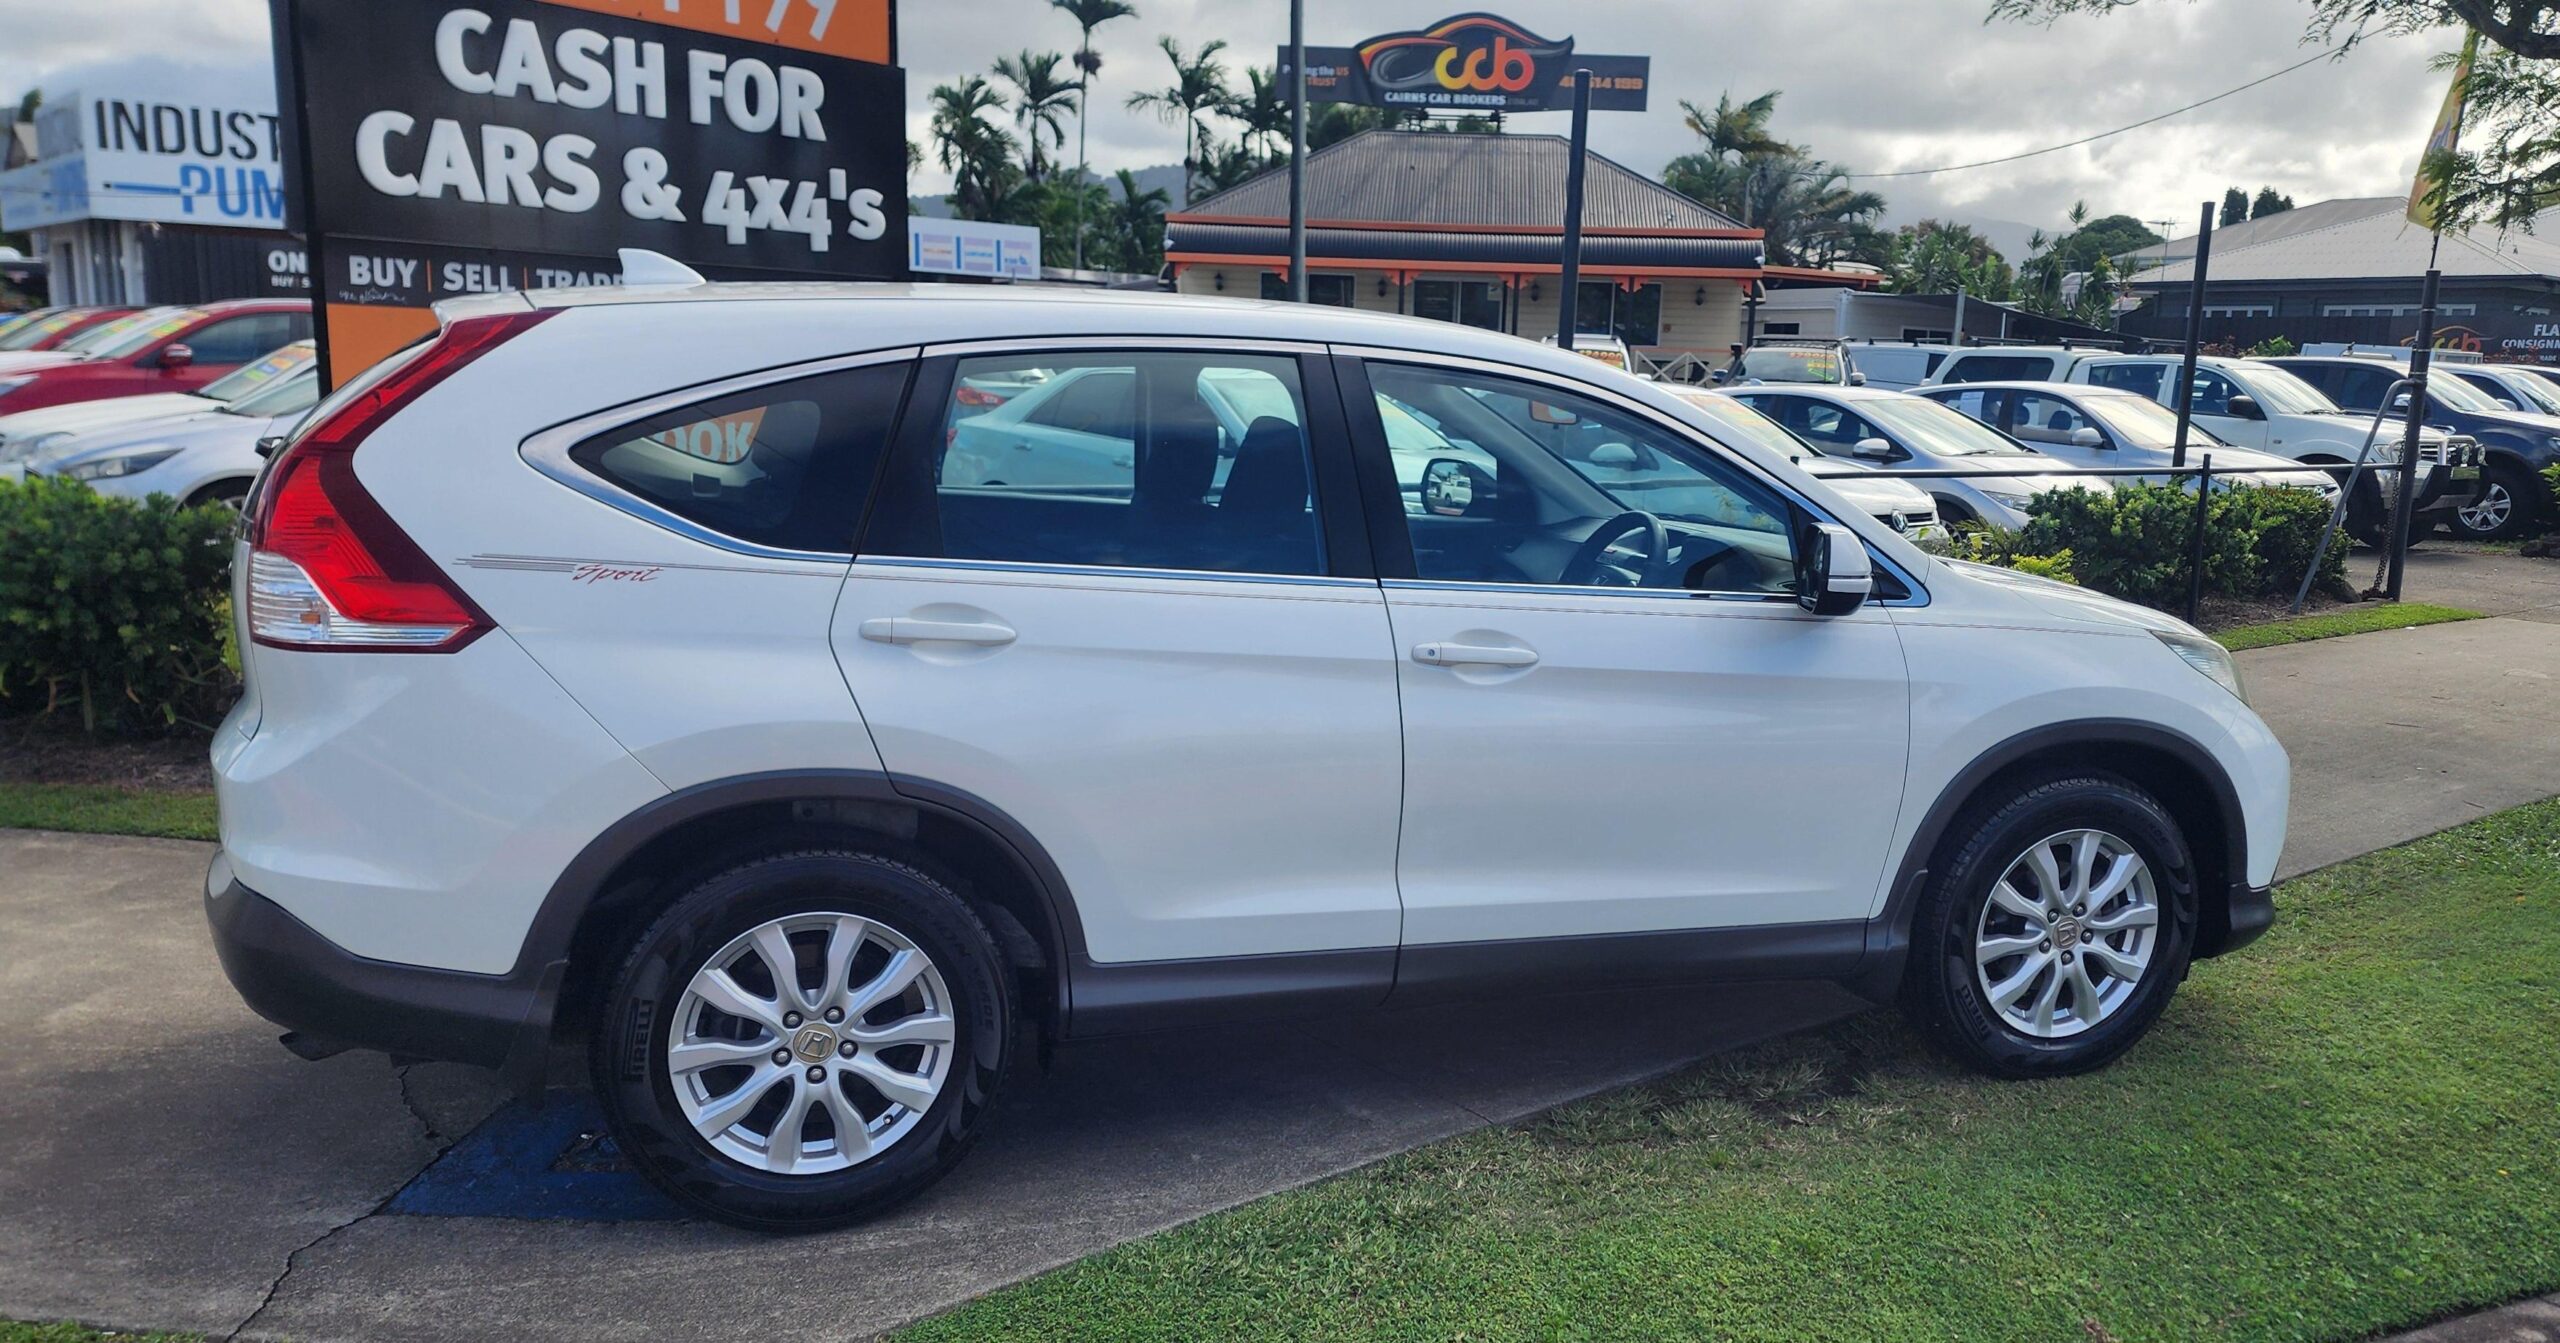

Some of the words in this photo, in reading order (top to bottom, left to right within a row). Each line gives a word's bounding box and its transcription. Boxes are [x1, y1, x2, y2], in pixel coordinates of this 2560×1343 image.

[435, 8, 667, 119] CASH
[688, 49, 827, 141] FOR
[1384, 91, 1427, 103] CAIRNS
[1428, 93, 1451, 104] CAR
[1453, 94, 1506, 105] BROKERS
[355, 110, 601, 213] CARS
[621, 146, 688, 223] &
[349, 255, 418, 289] BUY
[443, 261, 517, 293] SELL
[2533, 323, 2560, 337] FLA
[572, 563, 664, 585] Sport
